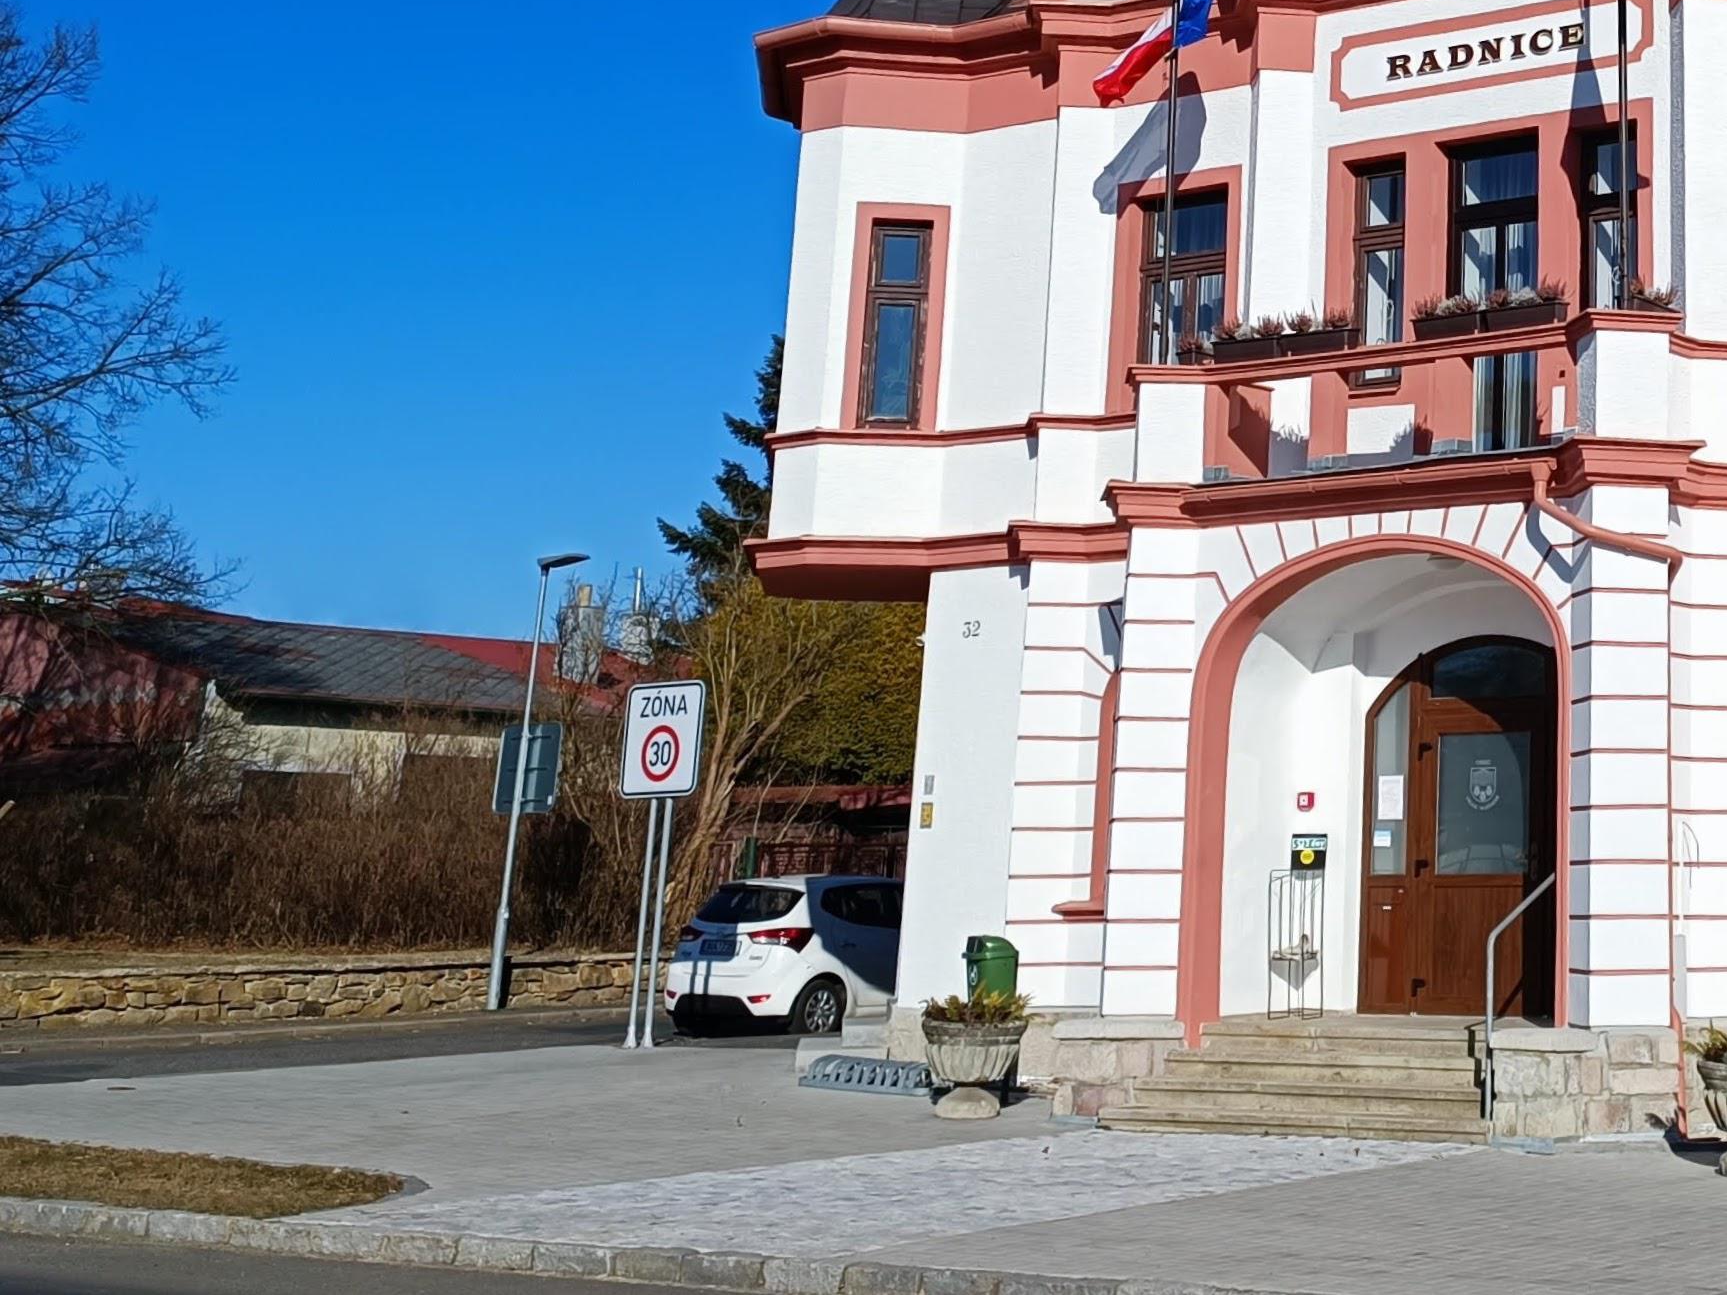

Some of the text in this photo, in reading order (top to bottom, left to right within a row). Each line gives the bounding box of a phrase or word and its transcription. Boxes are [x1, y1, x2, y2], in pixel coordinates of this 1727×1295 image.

[1386, 22, 1585, 81] RADNICE
[640, 690, 688, 718] ZÓNA
[649, 740, 672, 767] 30
